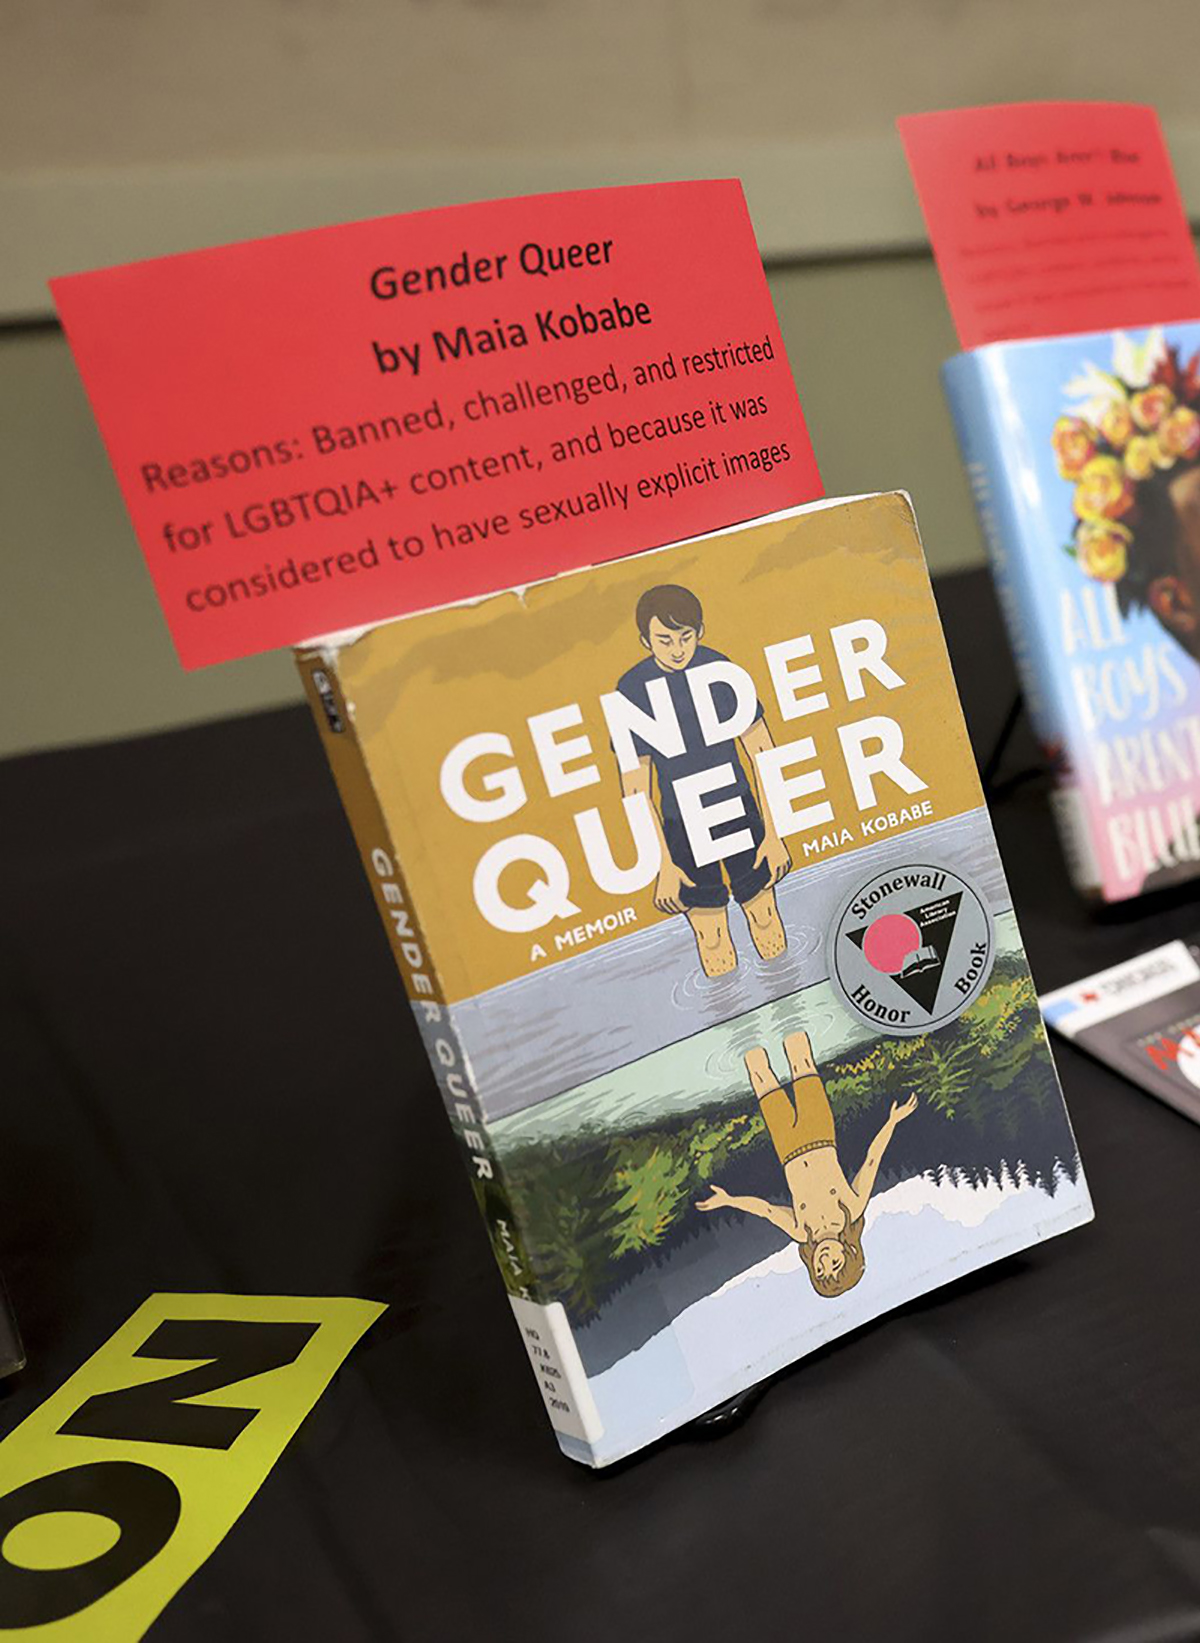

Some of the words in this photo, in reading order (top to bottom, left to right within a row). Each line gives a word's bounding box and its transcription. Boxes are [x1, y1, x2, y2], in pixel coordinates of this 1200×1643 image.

[370, 251, 508, 301] Gender
[519, 239, 614, 277] Queer
[372, 340, 421, 377] by
[432, 318, 528, 362] Maia
[535, 297, 653, 342] Kobabe
[140, 437, 304, 493] Reasons:
[311, 399, 456, 455] Banned,
[463, 364, 628, 422] challenged,
[633, 352, 678, 386] and
[682, 334, 775, 377] restricted
[162, 522, 214, 553] for
[224, 480, 398, 539] LGBTQIA+
[409, 445, 543, 496] content,
[550, 425, 602, 462] and
[607, 408, 706, 448] because
[708, 398, 728, 430] it
[729, 395, 769, 420] was
[185, 539, 380, 612] considered
[387, 536, 425, 561] to
[431, 514, 510, 550] have
[518, 480, 630, 530] sexually
[637, 457, 720, 498] explicit
[722, 441, 791, 473] images
[1060, 582, 1127, 657] ALL
[439, 618, 907, 823] GENDER
[1070, 641, 1189, 732] BOYS
[472, 715, 929, 936] QUEER
[802, 828, 854, 858] MAIA
[860, 800, 934, 839] KOBABE
[530, 943, 548, 963] A
[554, 906, 639, 952] MEMOIR
[851, 872, 947, 921] Stonewall
[850, 984, 911, 1024] Honor
[954, 941, 988, 996] Book
[371, 848, 441, 1024] GENDER
[435, 1038, 493, 1180] QUEER
[496, 1218, 524, 1276] MAIA
